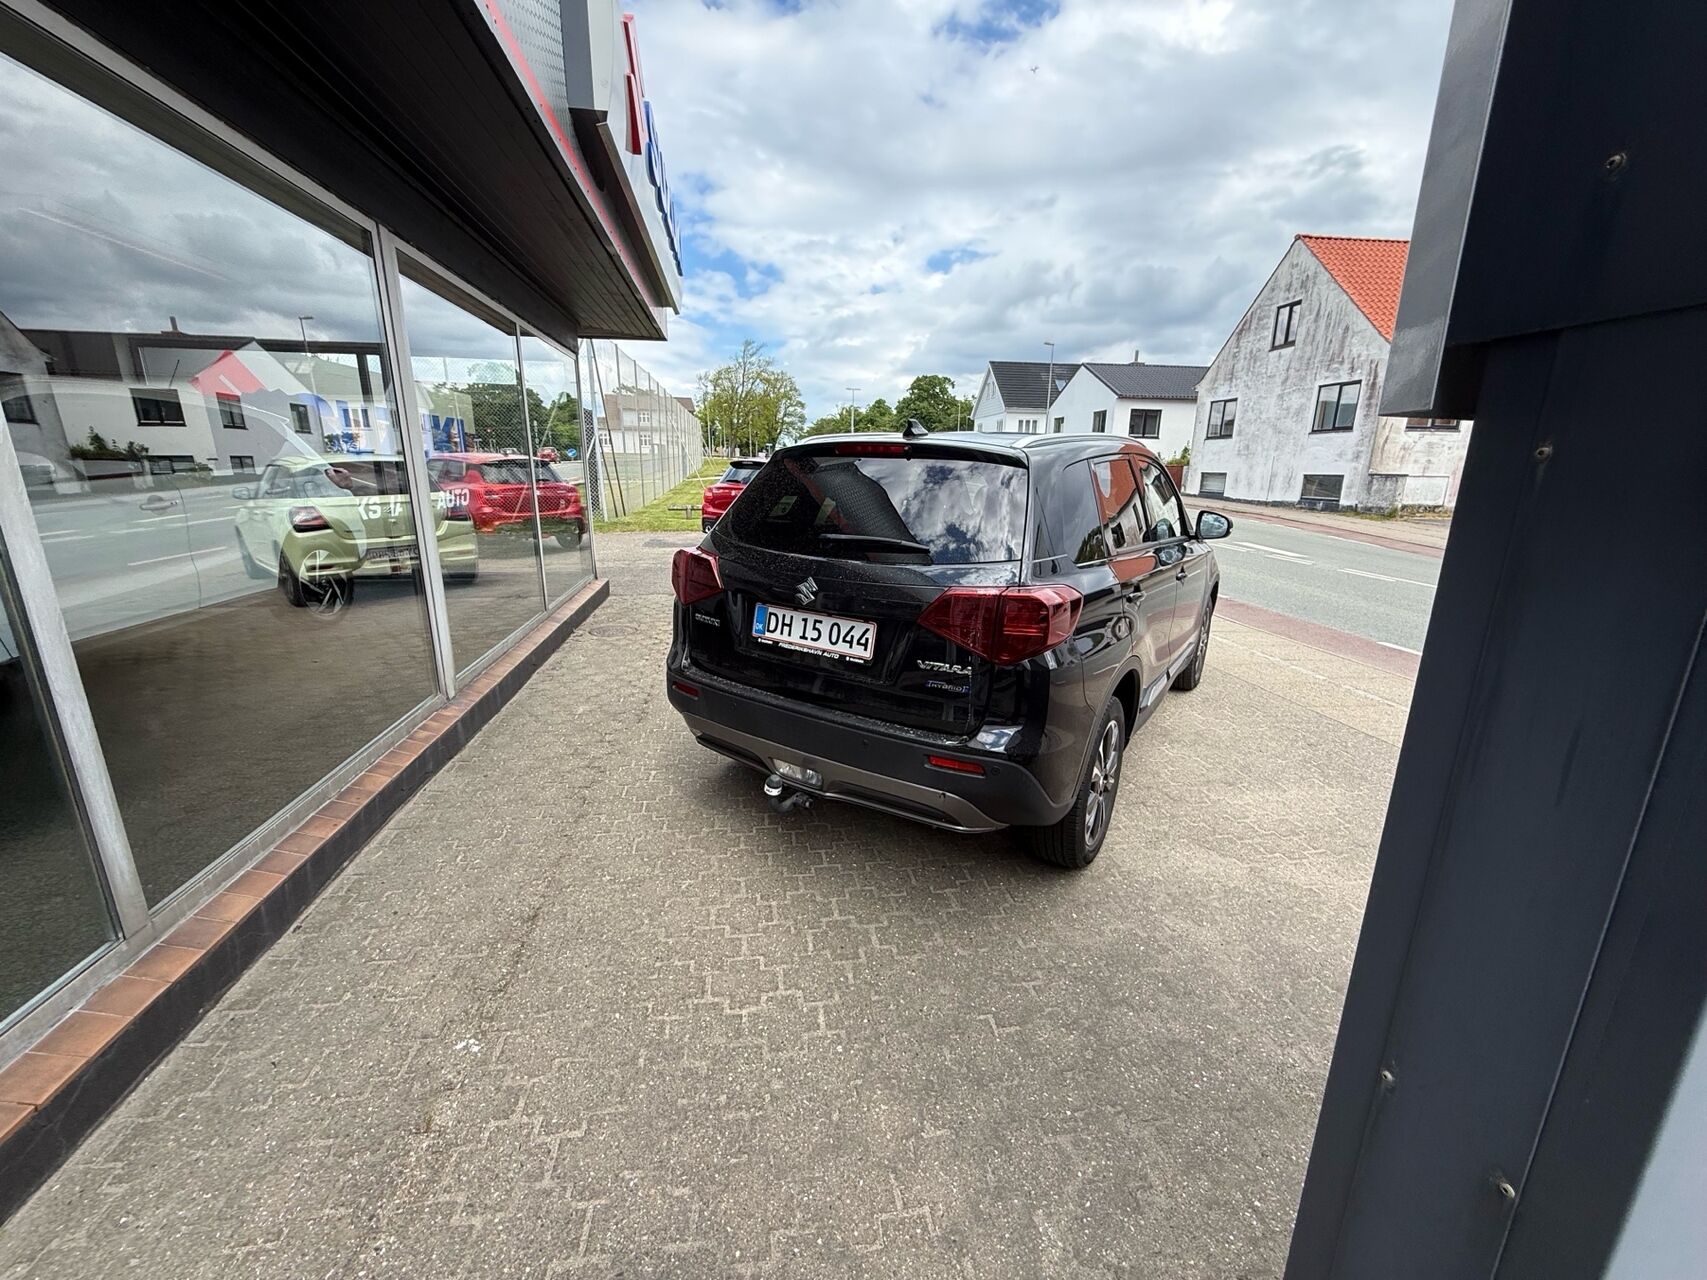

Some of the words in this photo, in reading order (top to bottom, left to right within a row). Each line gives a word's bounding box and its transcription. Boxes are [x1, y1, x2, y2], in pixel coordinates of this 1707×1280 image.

[437, 488, 470, 510] AUTO
[767, 611, 794, 637] DH
[799, 617, 823, 642] 15
[828, 621, 870, 652] 044
[823, 651, 840, 660] AUTO
